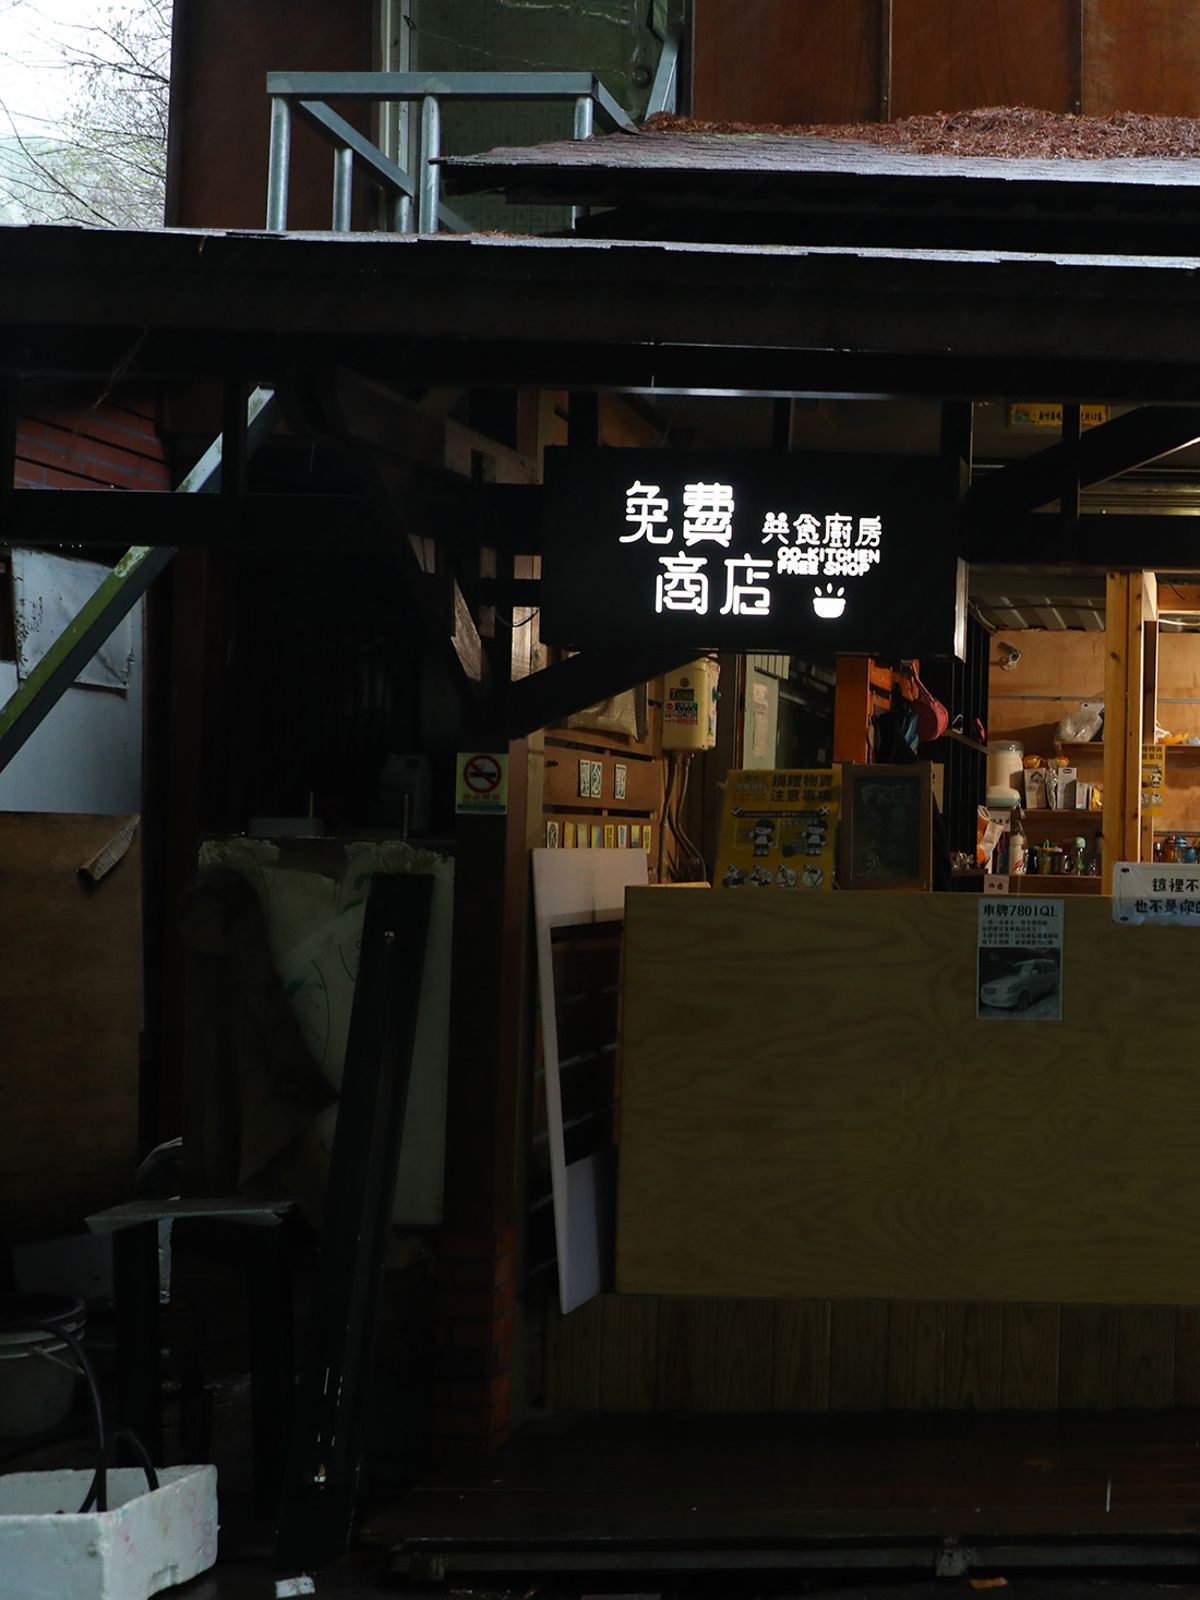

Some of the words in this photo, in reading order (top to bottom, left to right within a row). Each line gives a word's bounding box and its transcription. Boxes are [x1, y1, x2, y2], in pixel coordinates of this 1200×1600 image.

[618, 479, 735, 548] 免費
[777, 546, 881, 565] CO-KITCHEN
[777, 561, 819, 576] FREE
[823, 560, 871, 577] SHOP
[655, 550, 775, 616] 商店
